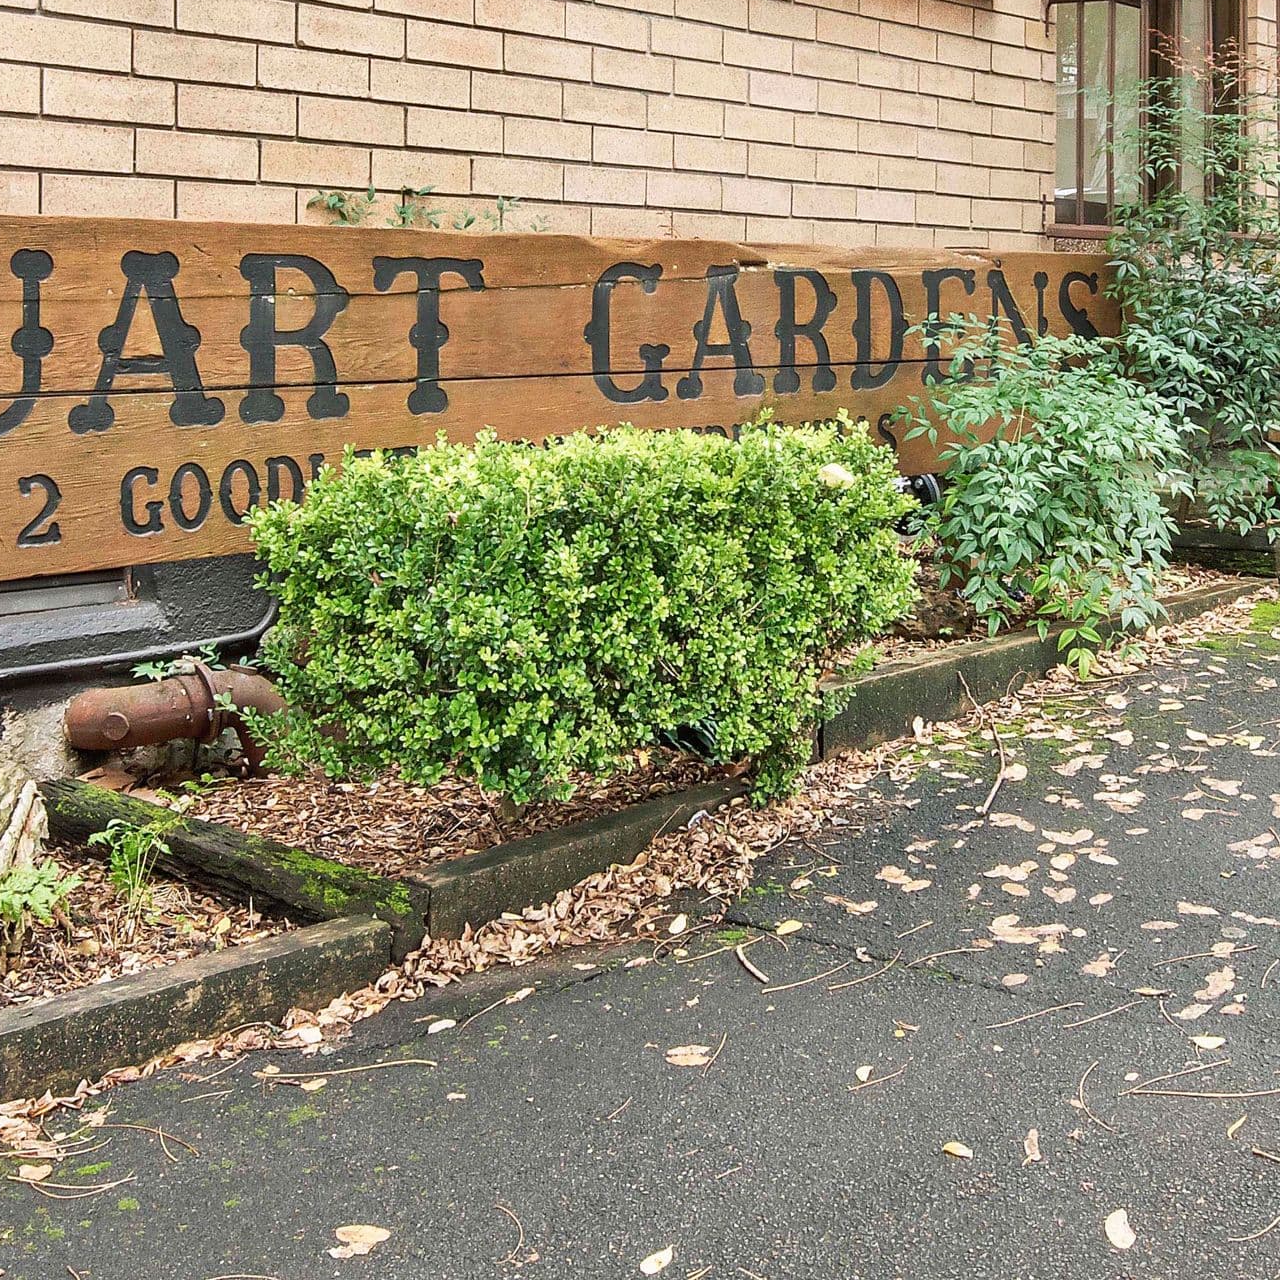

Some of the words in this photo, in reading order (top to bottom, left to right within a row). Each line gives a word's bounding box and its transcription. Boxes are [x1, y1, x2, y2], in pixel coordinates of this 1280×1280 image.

[585, 261, 1099, 404] GARDENS
[16, 473, 62, 548] 2
[120, 444, 420, 537] GOOD
